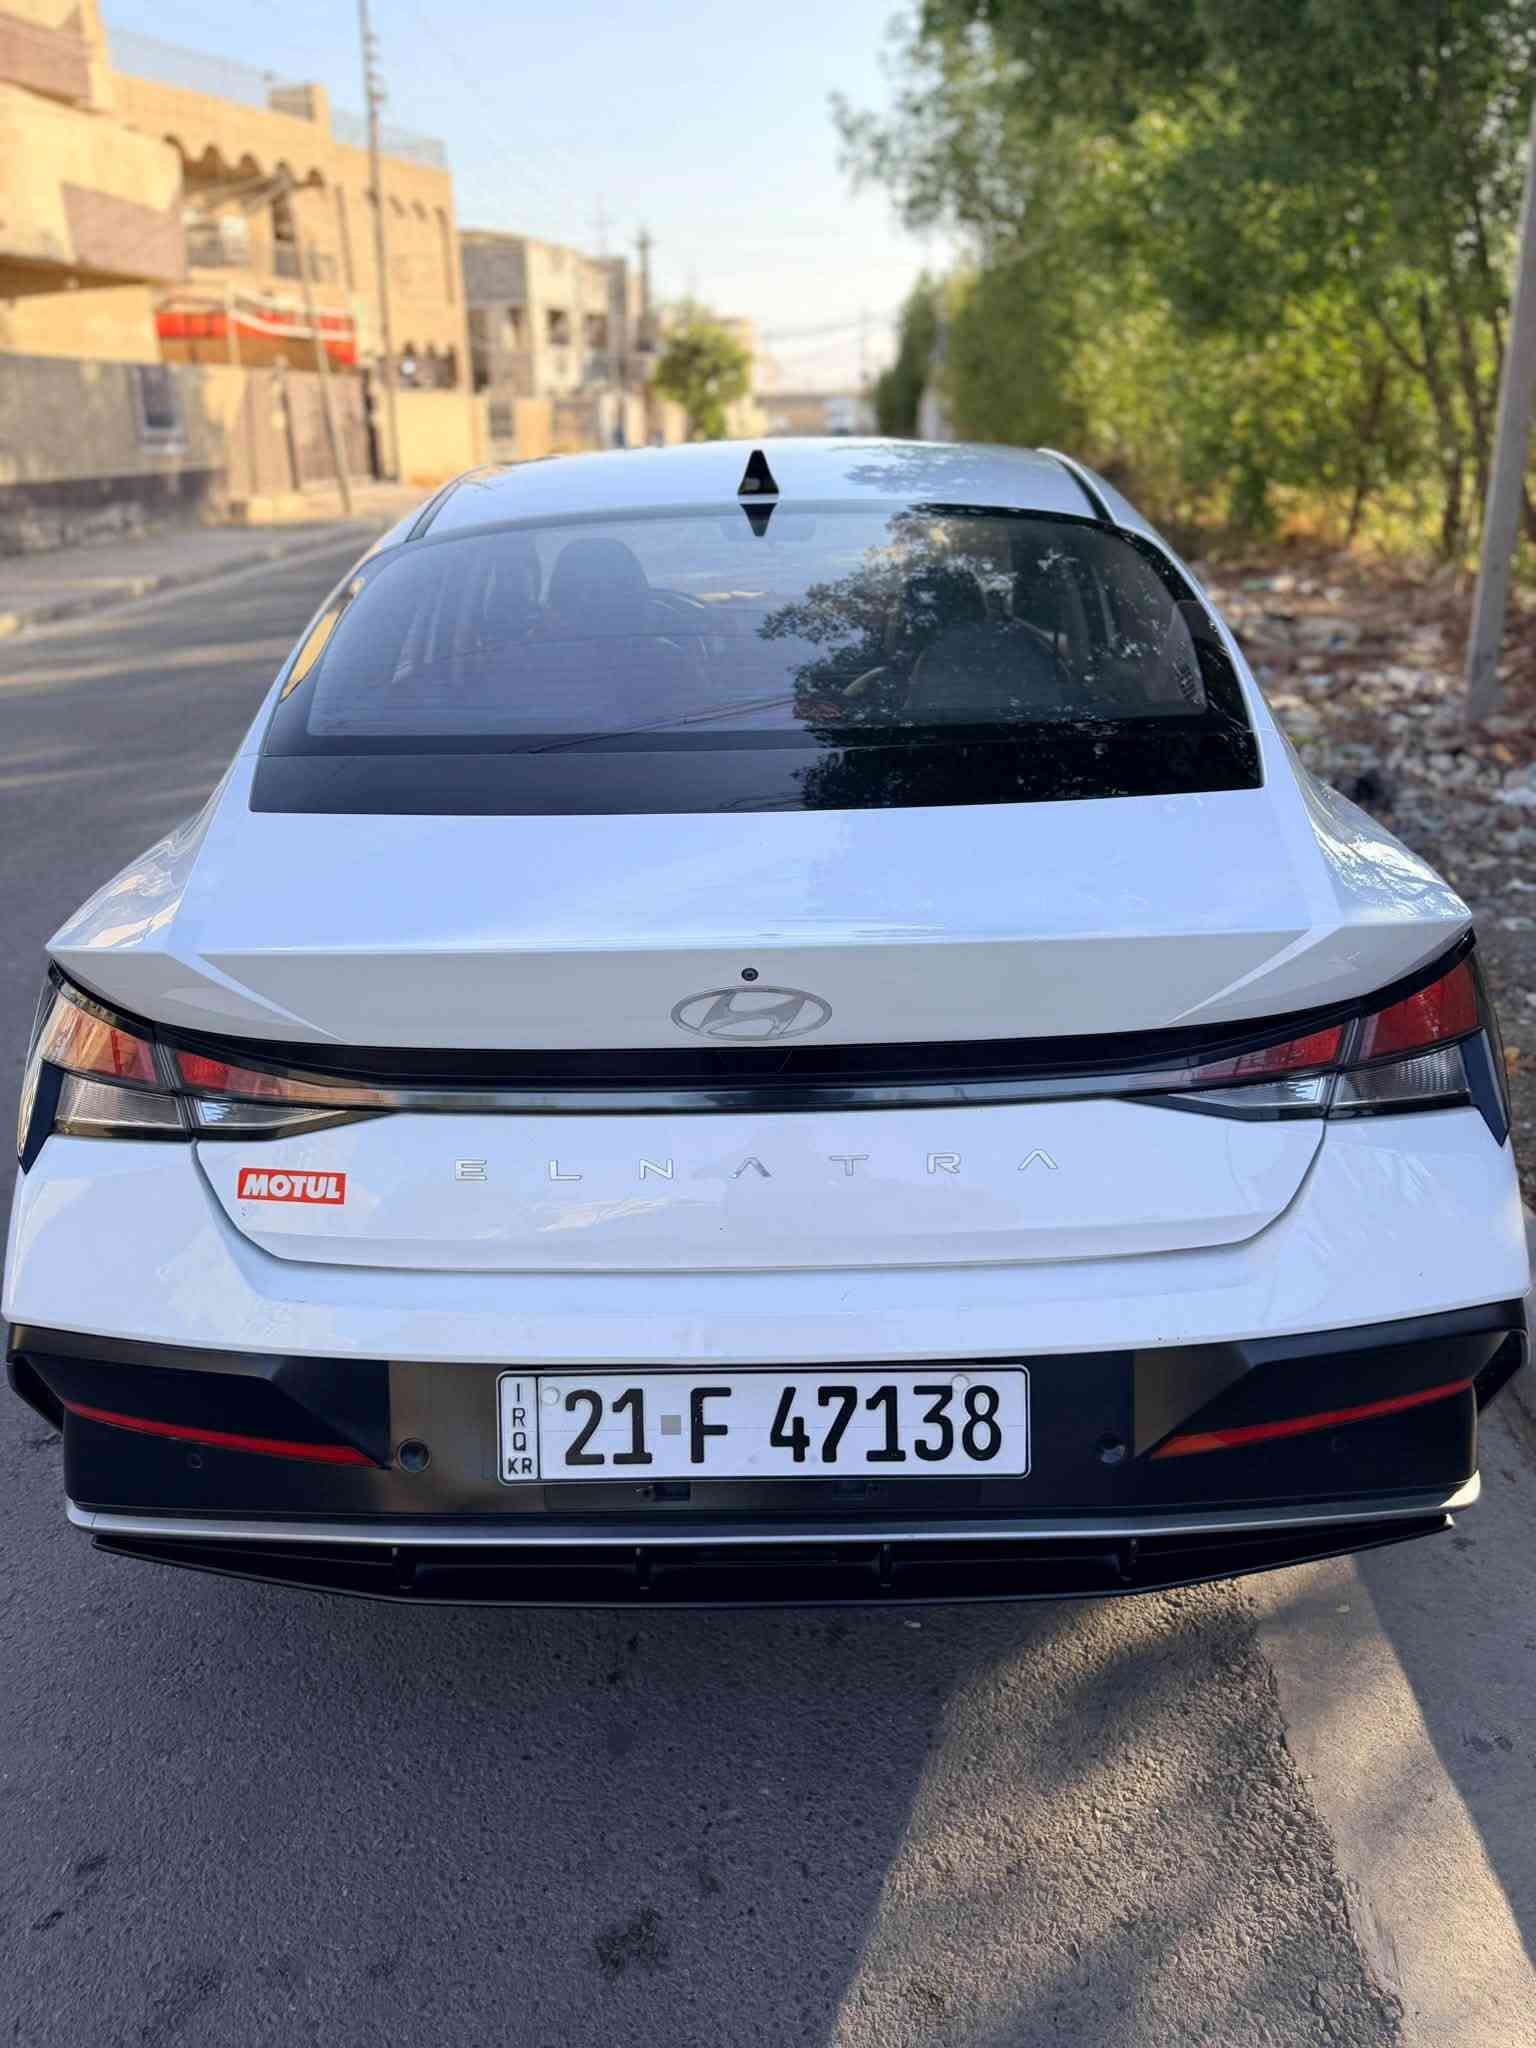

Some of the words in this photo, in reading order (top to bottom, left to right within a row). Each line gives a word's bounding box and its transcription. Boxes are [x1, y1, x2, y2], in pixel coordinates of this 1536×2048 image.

[243, 1174, 340, 1199] MOTUL
[565, 1389, 653, 1465] 21
[691, 1387, 732, 1463] F
[769, 1384, 1002, 1463] 47138
[507, 1457, 533, 1475] KR
